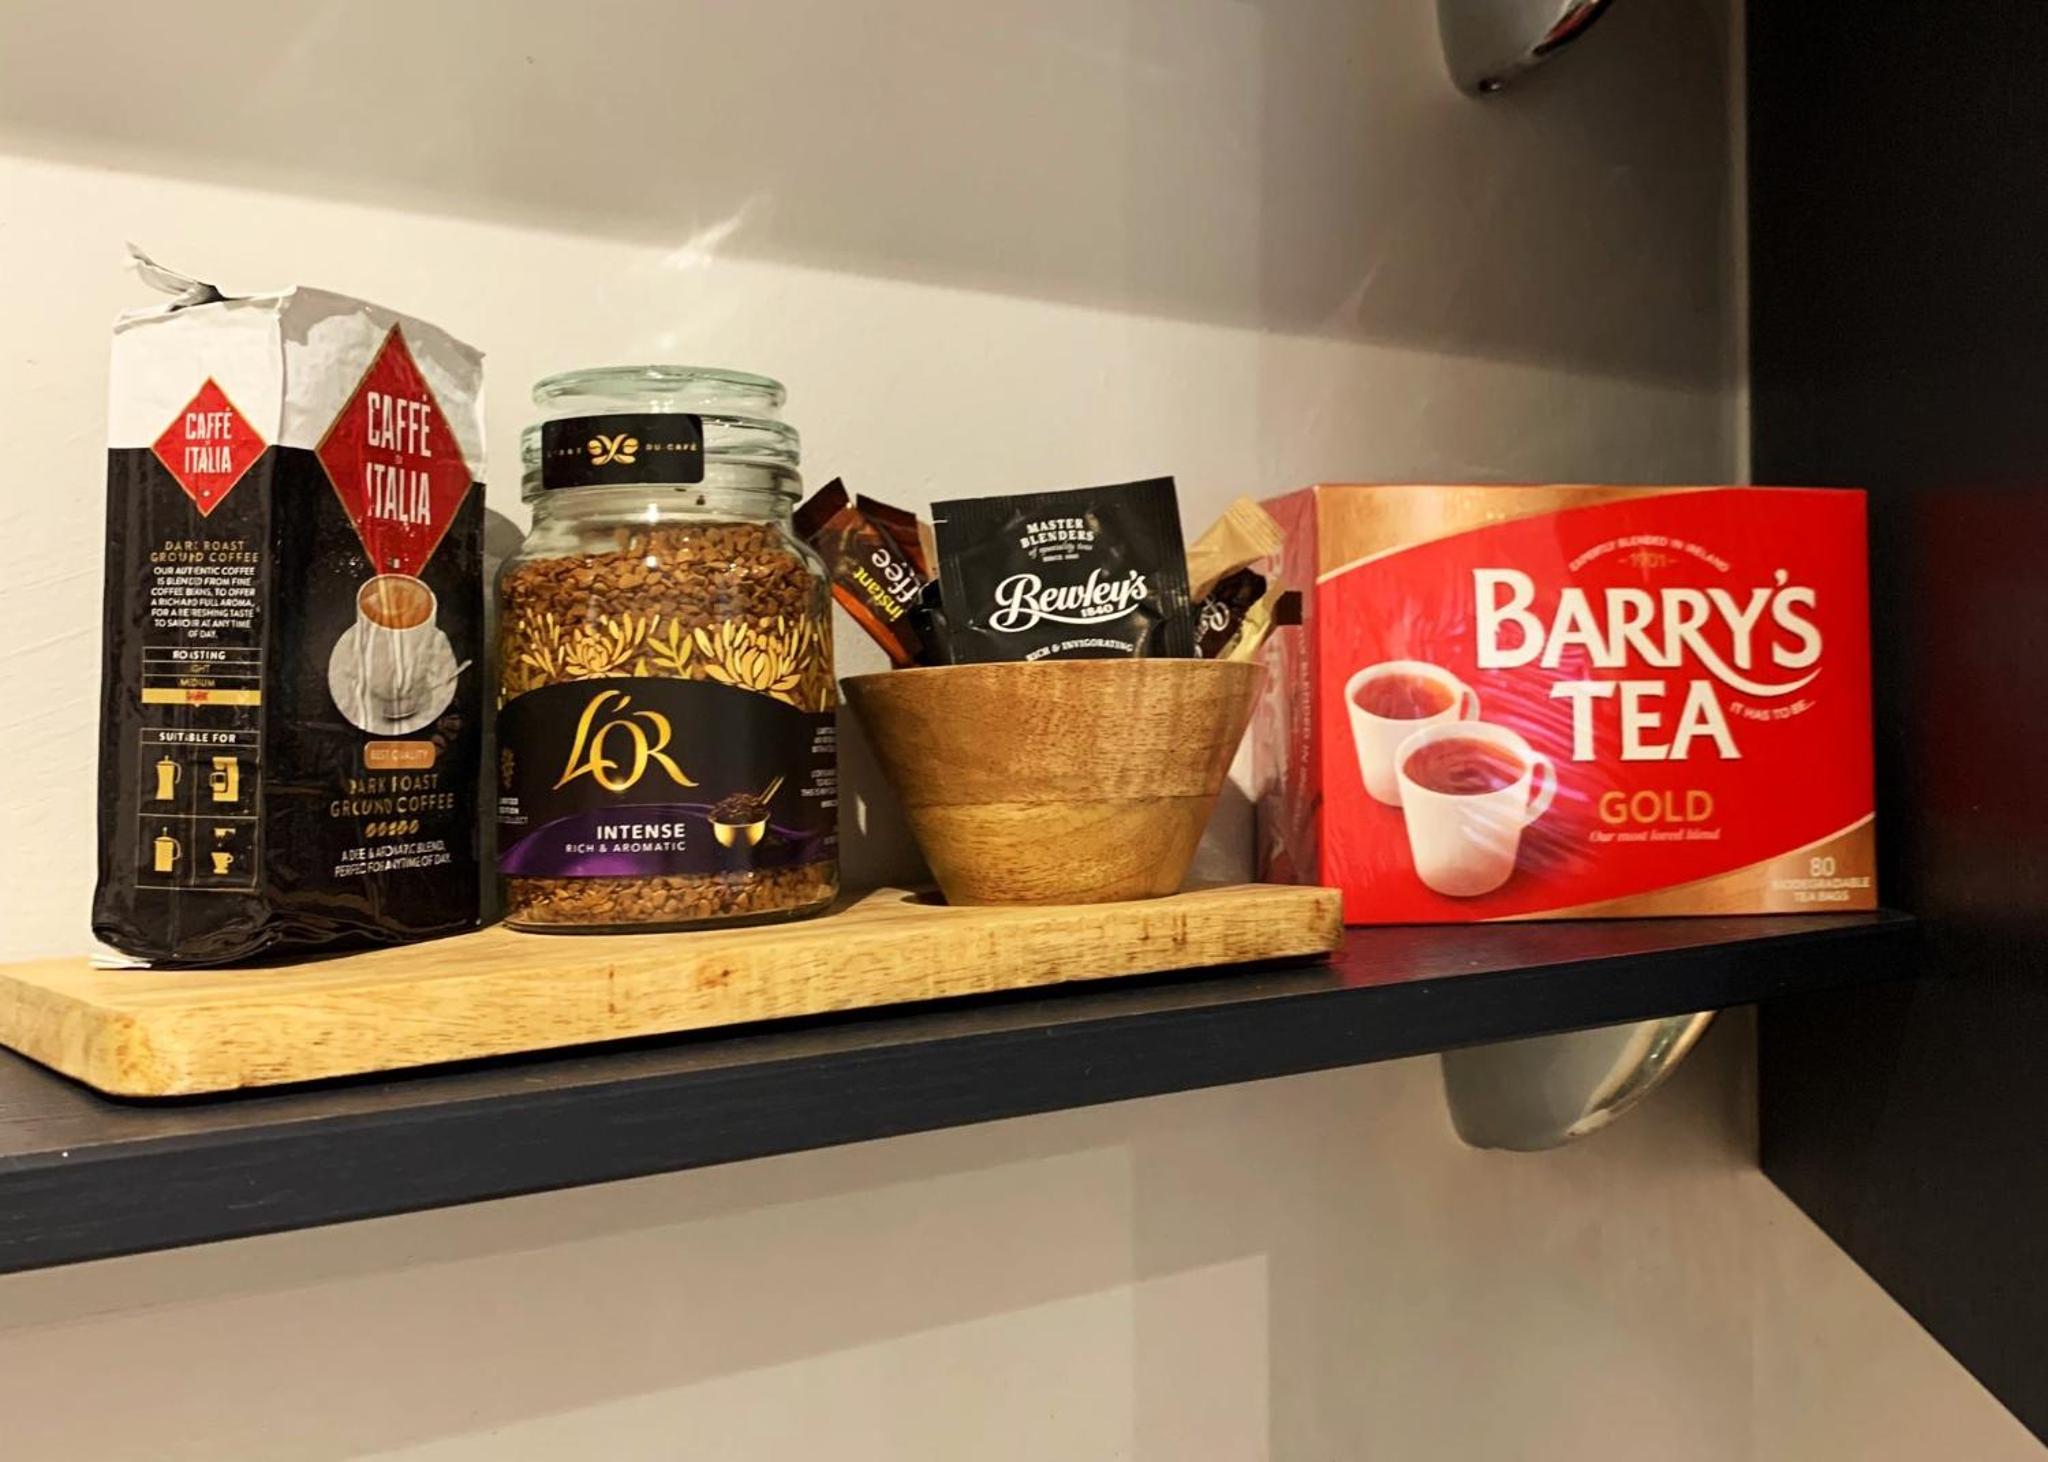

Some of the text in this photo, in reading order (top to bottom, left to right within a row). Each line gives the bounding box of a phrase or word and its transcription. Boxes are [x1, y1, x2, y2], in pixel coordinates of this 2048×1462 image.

[185, 446, 232, 474] ITALIA
[366, 462, 431, 526] ITALIA
[1026, 518, 1084, 534] MASTER
[203, 540, 244, 552] ROAST
[1020, 530, 1095, 549] BLENDERS
[208, 552, 259, 562] COFFEE
[153, 567, 174, 576] OUR
[221, 567, 256, 576] COFFEE
[871, 548, 920, 603] ffee
[157, 577, 165, 586] IS
[204, 577, 230, 586] FROM
[232, 577, 252, 586] FINE
[151, 587, 183, 596] COFFEE
[214, 588, 227, 596] TO
[228, 588, 256, 597] OFFER
[852, 566, 904, 623] instant
[150, 598, 157, 606] A
[200, 598, 219, 607] FULL
[988, 567, 1148, 633] Bewley's
[151, 608, 254, 617] FOR A RERESHING TASTE
[1081, 604, 1114, 618] 1840
[155, 619, 166, 628] TO
[201, 619, 211, 628] AT
[187, 630, 198, 638] OF
[1472, 567, 1823, 697] BARRY'S
[1061, 638, 1134, 653] INVIGORATING
[172, 650, 227, 660] ROASTING
[1550, 680, 1743, 762] TEA
[159, 731, 237, 743] SUITABLE FOR
[396, 793, 455, 813] COFFEE
[1599, 789, 1715, 825] GOLD
[596, 823, 687, 840] INTENSE
[565, 841, 687, 853] RICH & AROMATIC
[1810, 856, 1836, 877] 80
[1793, 889, 1851, 903] TEA BAGS
